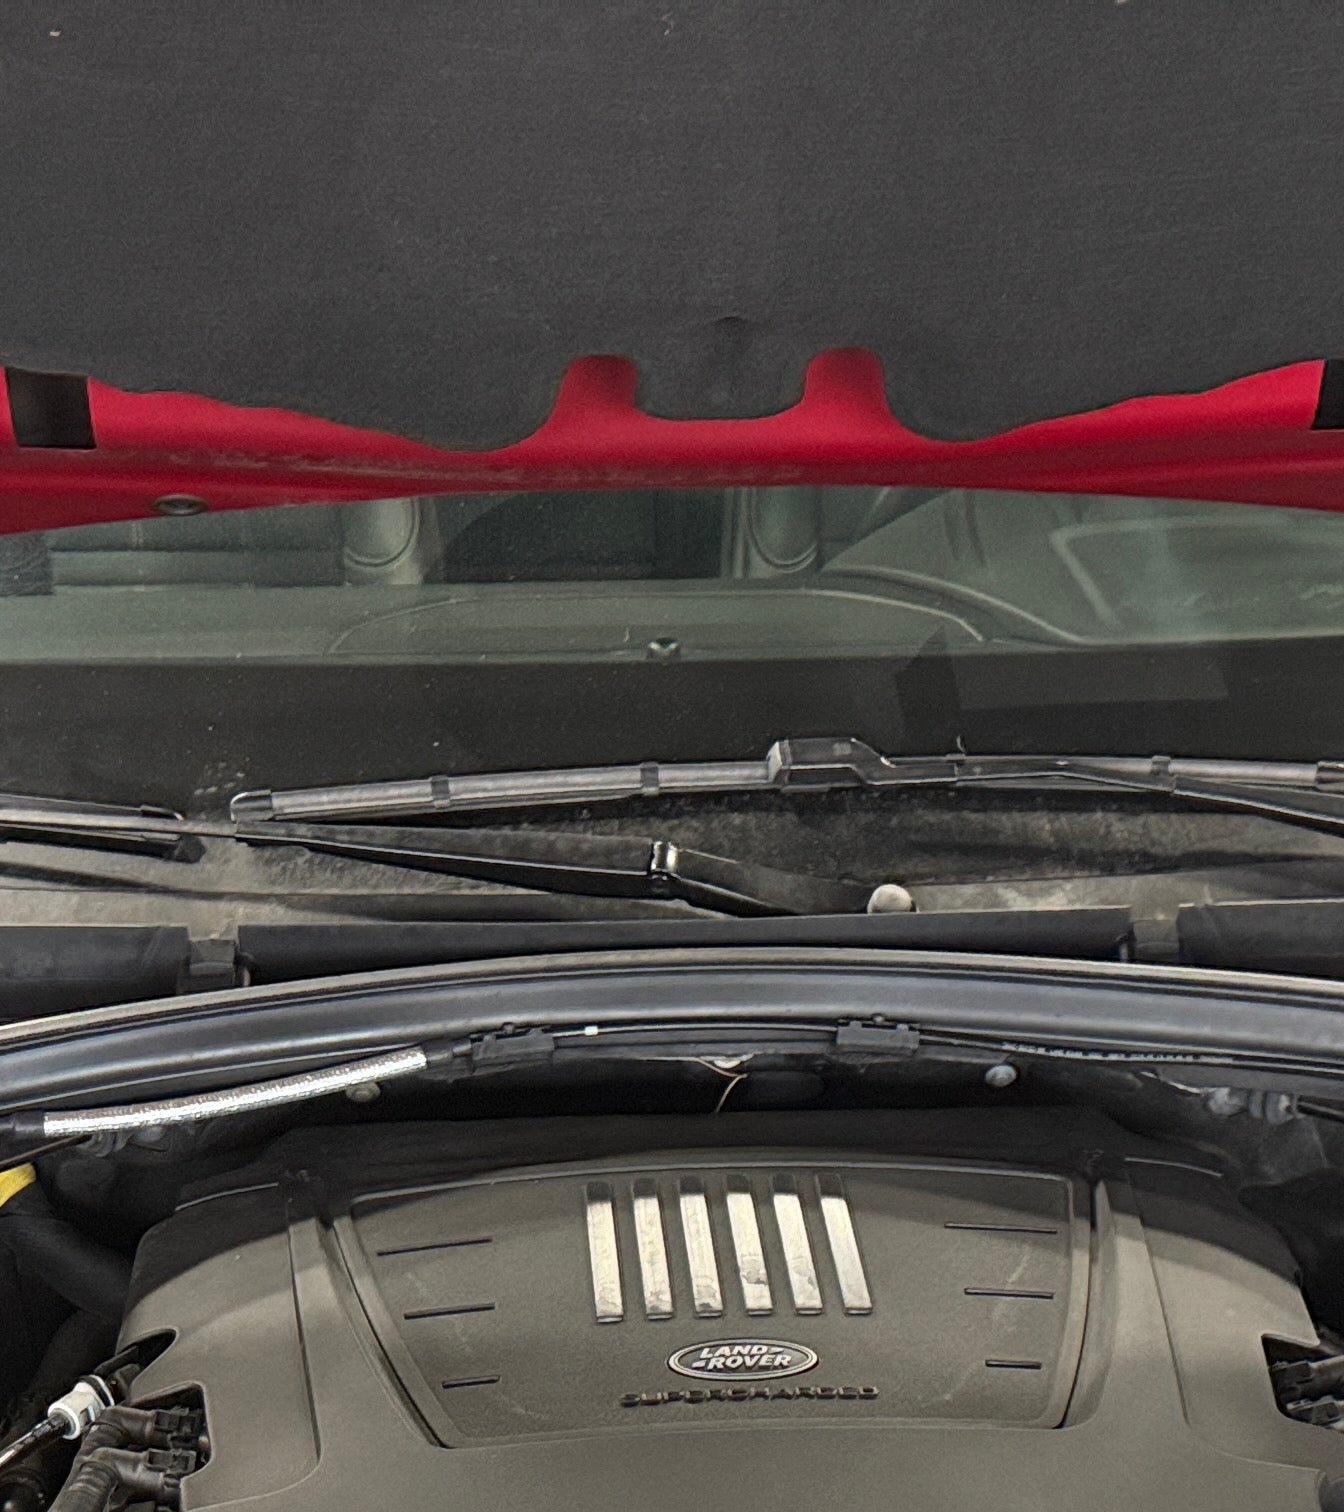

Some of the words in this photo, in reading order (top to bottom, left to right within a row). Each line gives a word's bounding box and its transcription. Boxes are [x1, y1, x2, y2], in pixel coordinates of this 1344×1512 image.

[699, 1344, 768, 1359] LAND
[707, 1354, 793, 1370] ROVER
[620, 1386, 880, 1407] SUPERCHARGED
